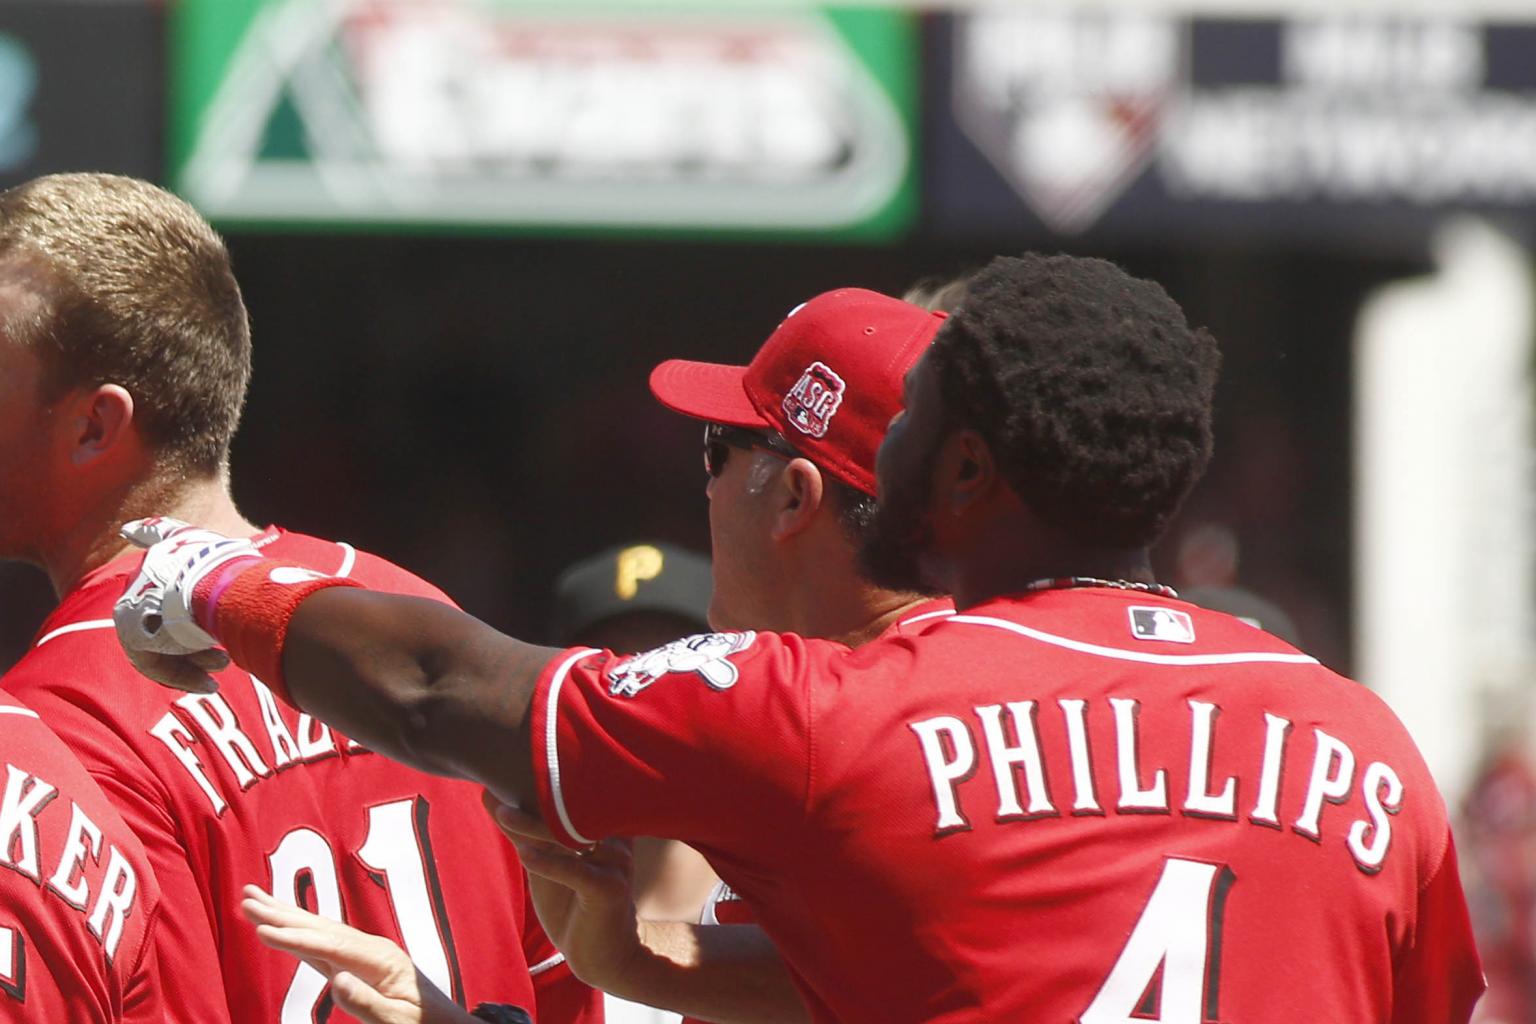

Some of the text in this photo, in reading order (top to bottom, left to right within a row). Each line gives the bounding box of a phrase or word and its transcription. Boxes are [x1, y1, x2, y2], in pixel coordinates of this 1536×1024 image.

[794, 374, 834, 419] ASG
[616, 544, 664, 600] P
[909, 697, 1404, 874] PHILLIPS
